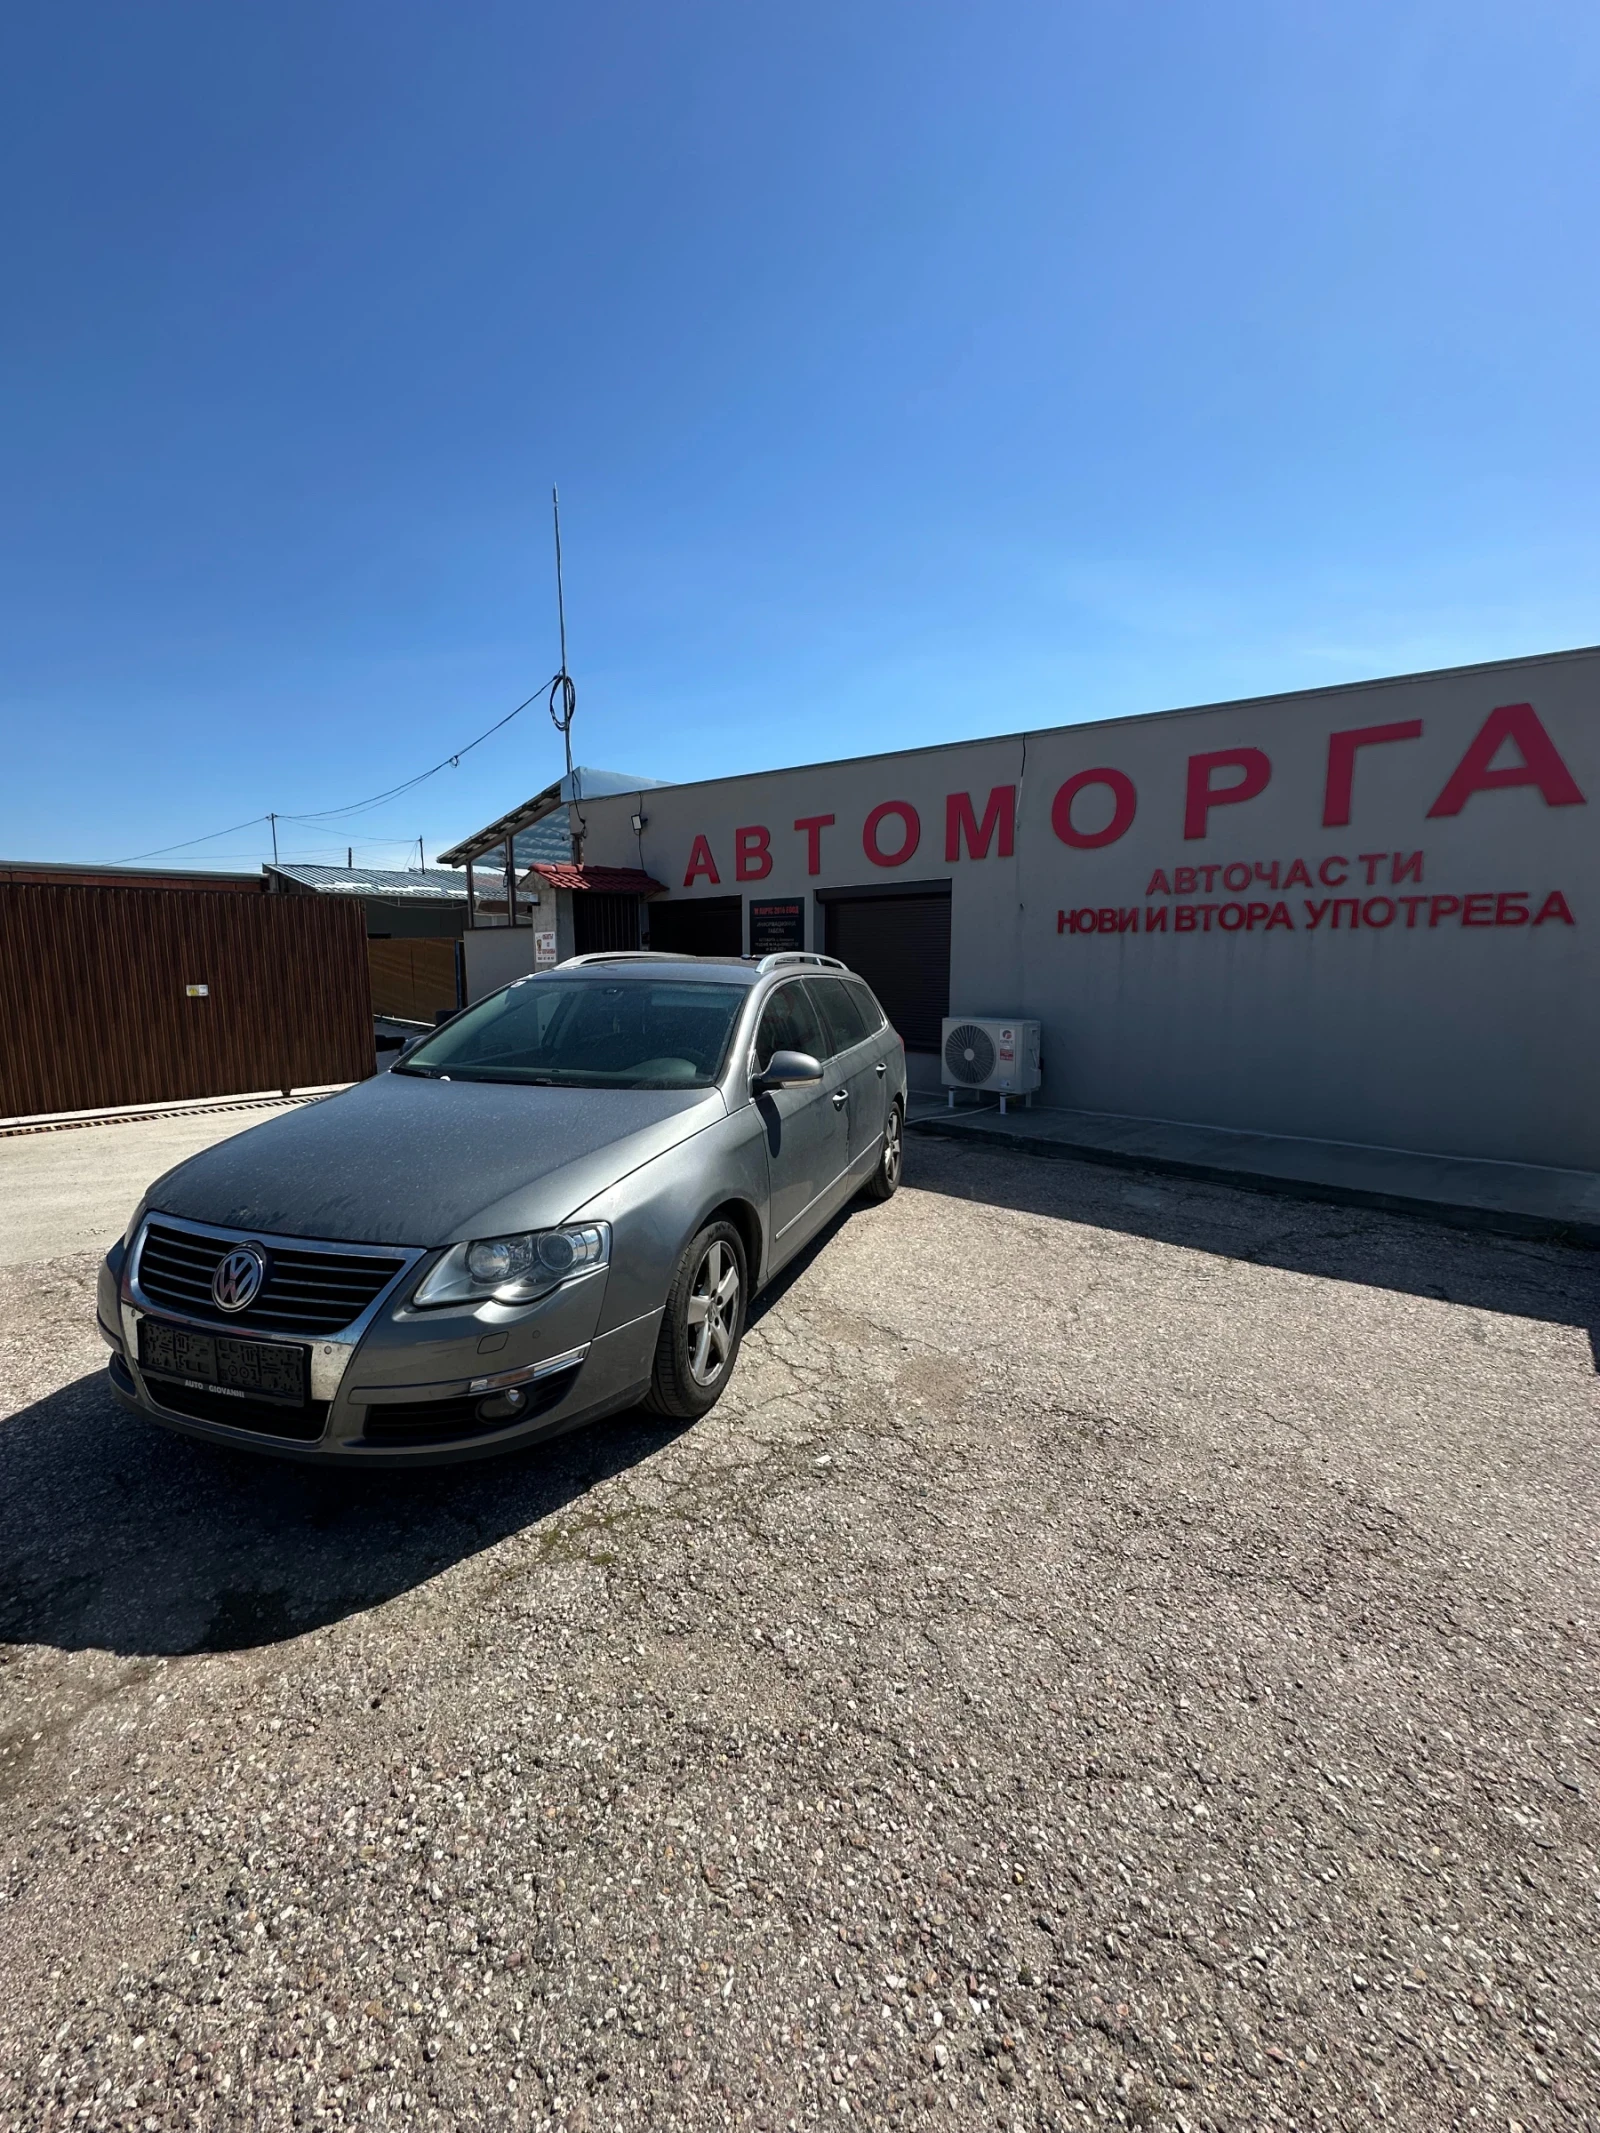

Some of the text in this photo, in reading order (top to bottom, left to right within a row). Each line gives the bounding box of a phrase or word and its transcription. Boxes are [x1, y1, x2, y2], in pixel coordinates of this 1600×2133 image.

[683, 703, 1586, 886] АВТОМОРГА
[1146, 850, 1424, 896] АВТОЧАСТИ
[1057, 890, 1576, 934] НОВИ И ВТОРА УПОТРЕБА
[184, 1379, 245, 1398] AUTO GIOVANNI
